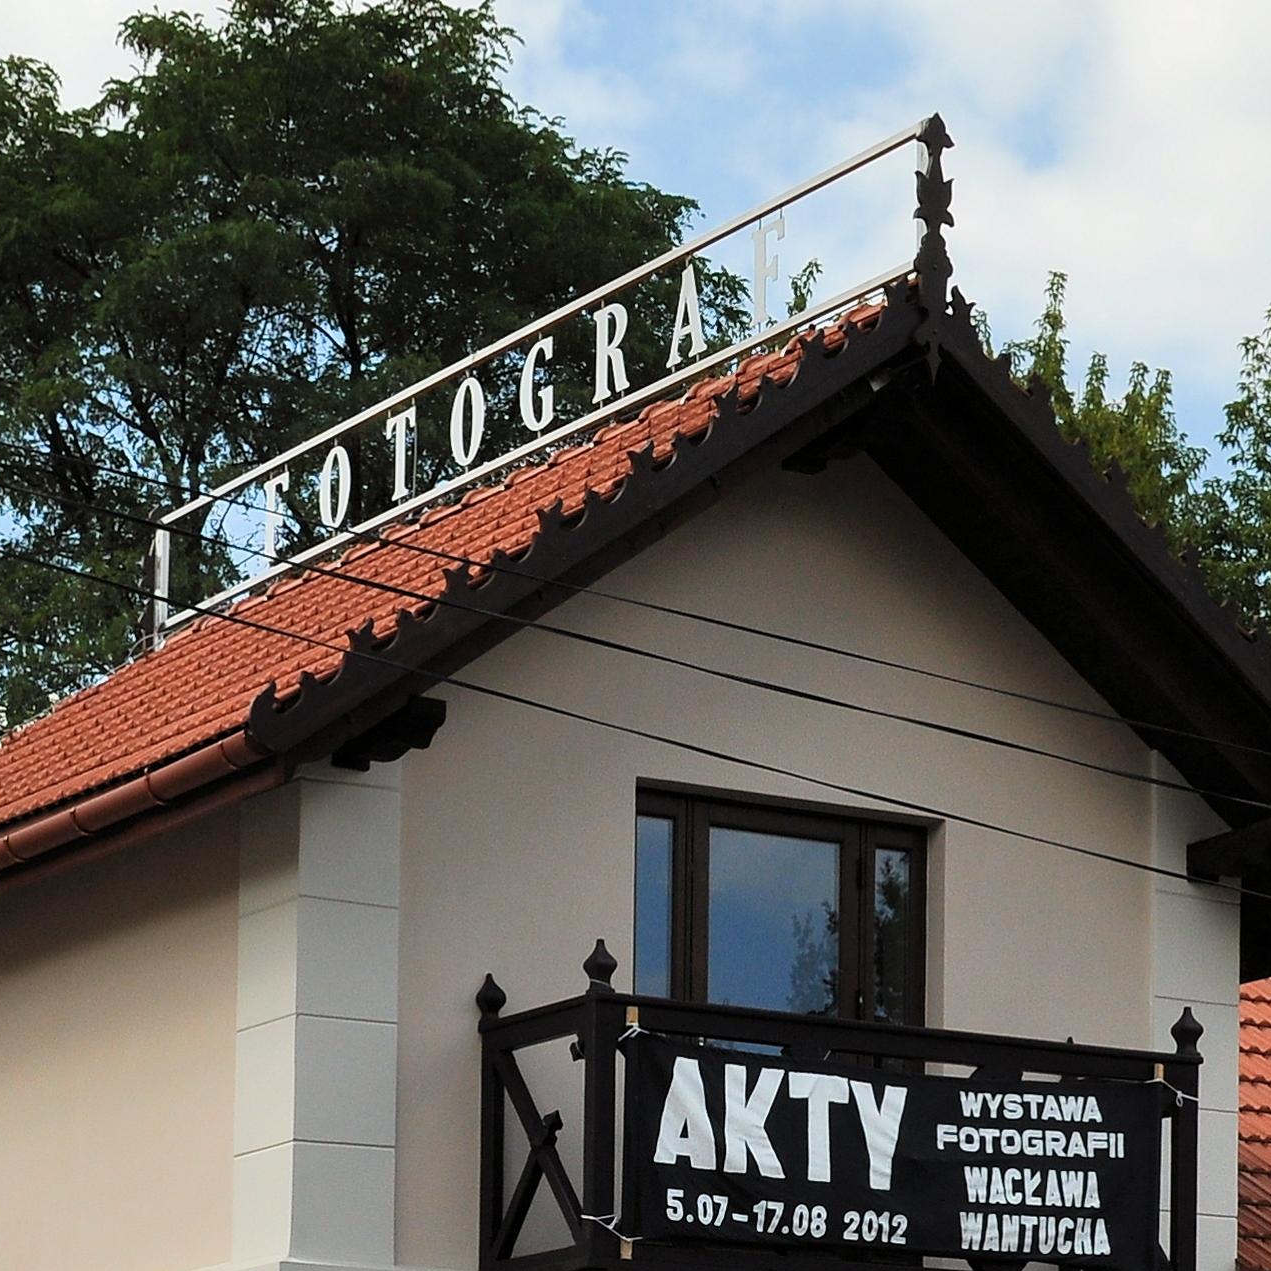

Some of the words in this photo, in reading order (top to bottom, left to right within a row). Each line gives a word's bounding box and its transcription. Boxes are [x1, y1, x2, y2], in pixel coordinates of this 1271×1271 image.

[262, 215, 786, 560] FOTOGRAF
[653, 1056, 908, 1191] AKTY
[959, 1090, 1103, 1123] WYSTAWA
[936, 1123, 1125, 1159] FOTOGRAFII
[963, 1165, 1101, 1209] WACŁAWA
[842, 1210, 908, 1245] 2012
[959, 1211, 1111, 1256] WANTUCHA
